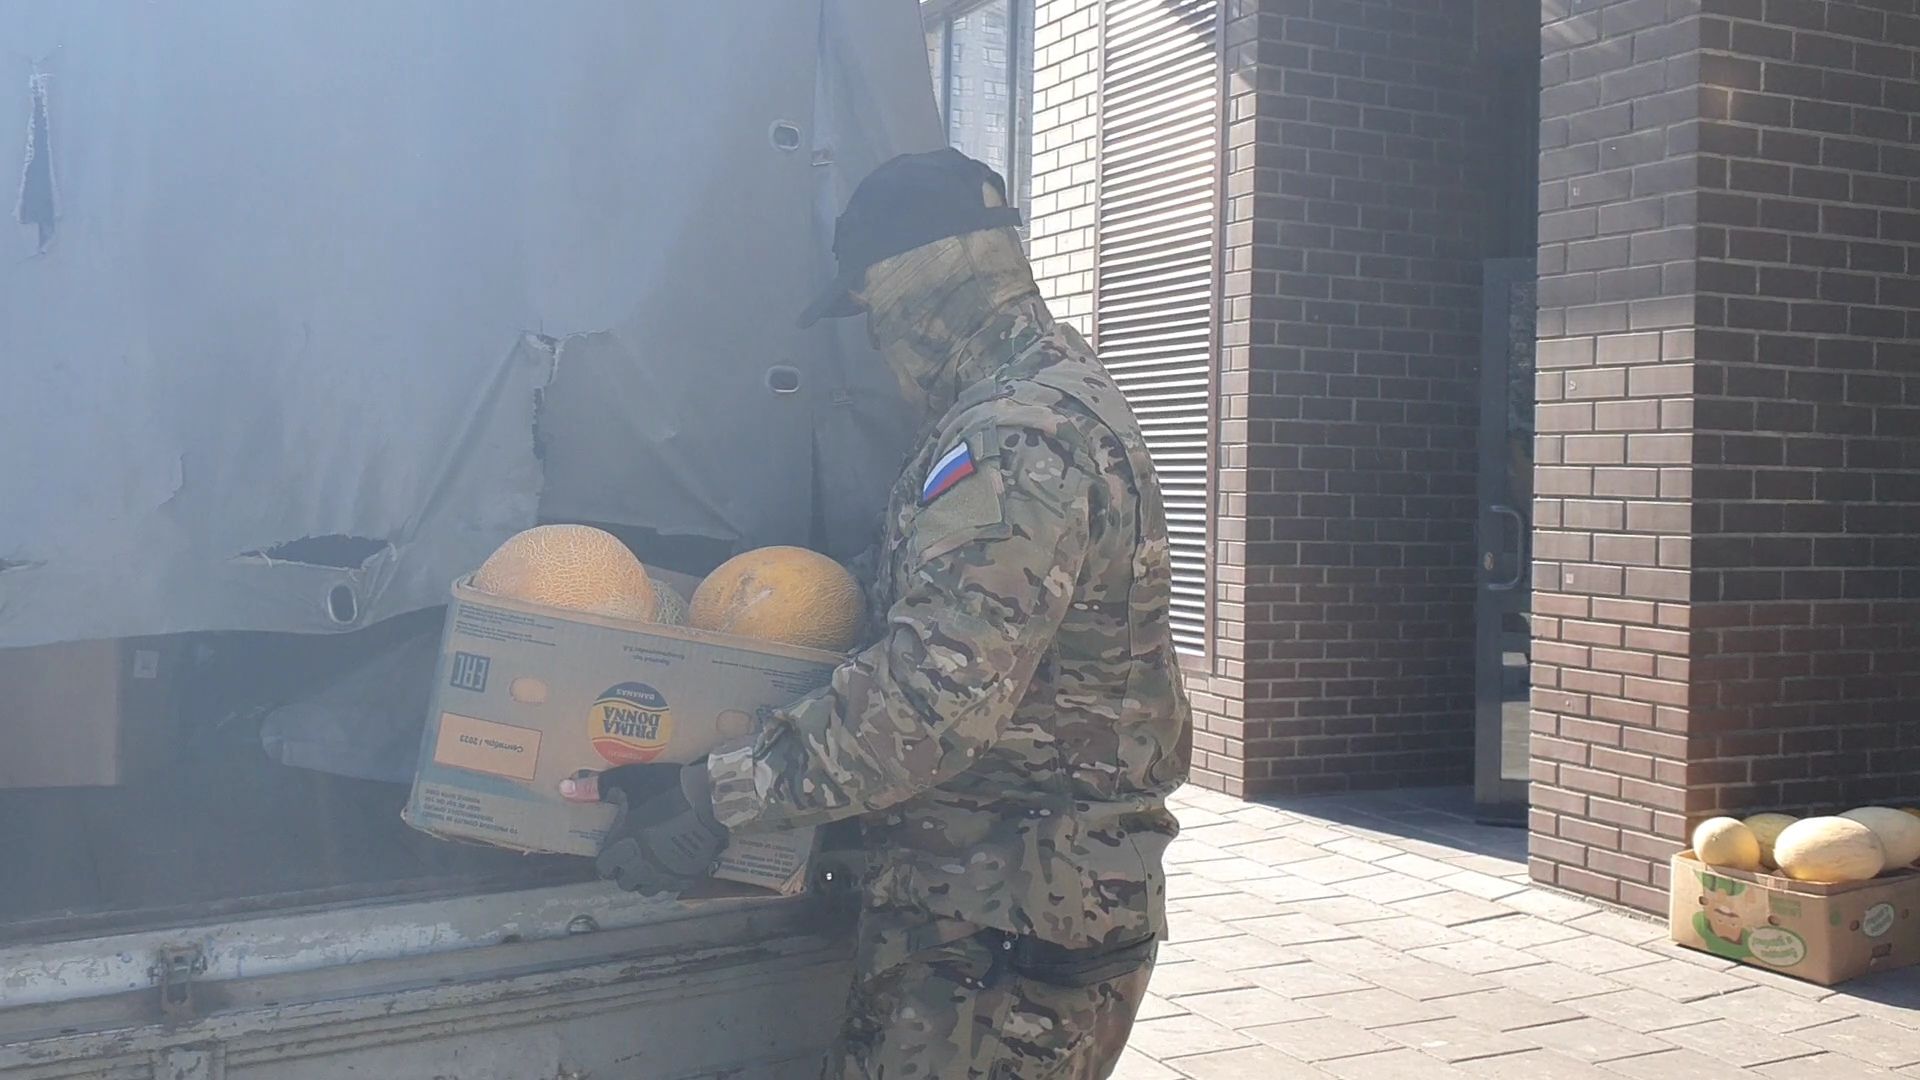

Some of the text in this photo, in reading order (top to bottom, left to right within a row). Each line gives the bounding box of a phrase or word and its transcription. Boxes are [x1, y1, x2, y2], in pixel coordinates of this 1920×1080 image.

[452, 653, 489, 692] EAC
[615, 688, 656, 701] BANANAS
[603, 706, 662, 727] DONNA
[603, 719, 658, 740] PRIMA
[459, 733, 479, 747] 2023
[484, 739, 524, 754] Сентябрь
